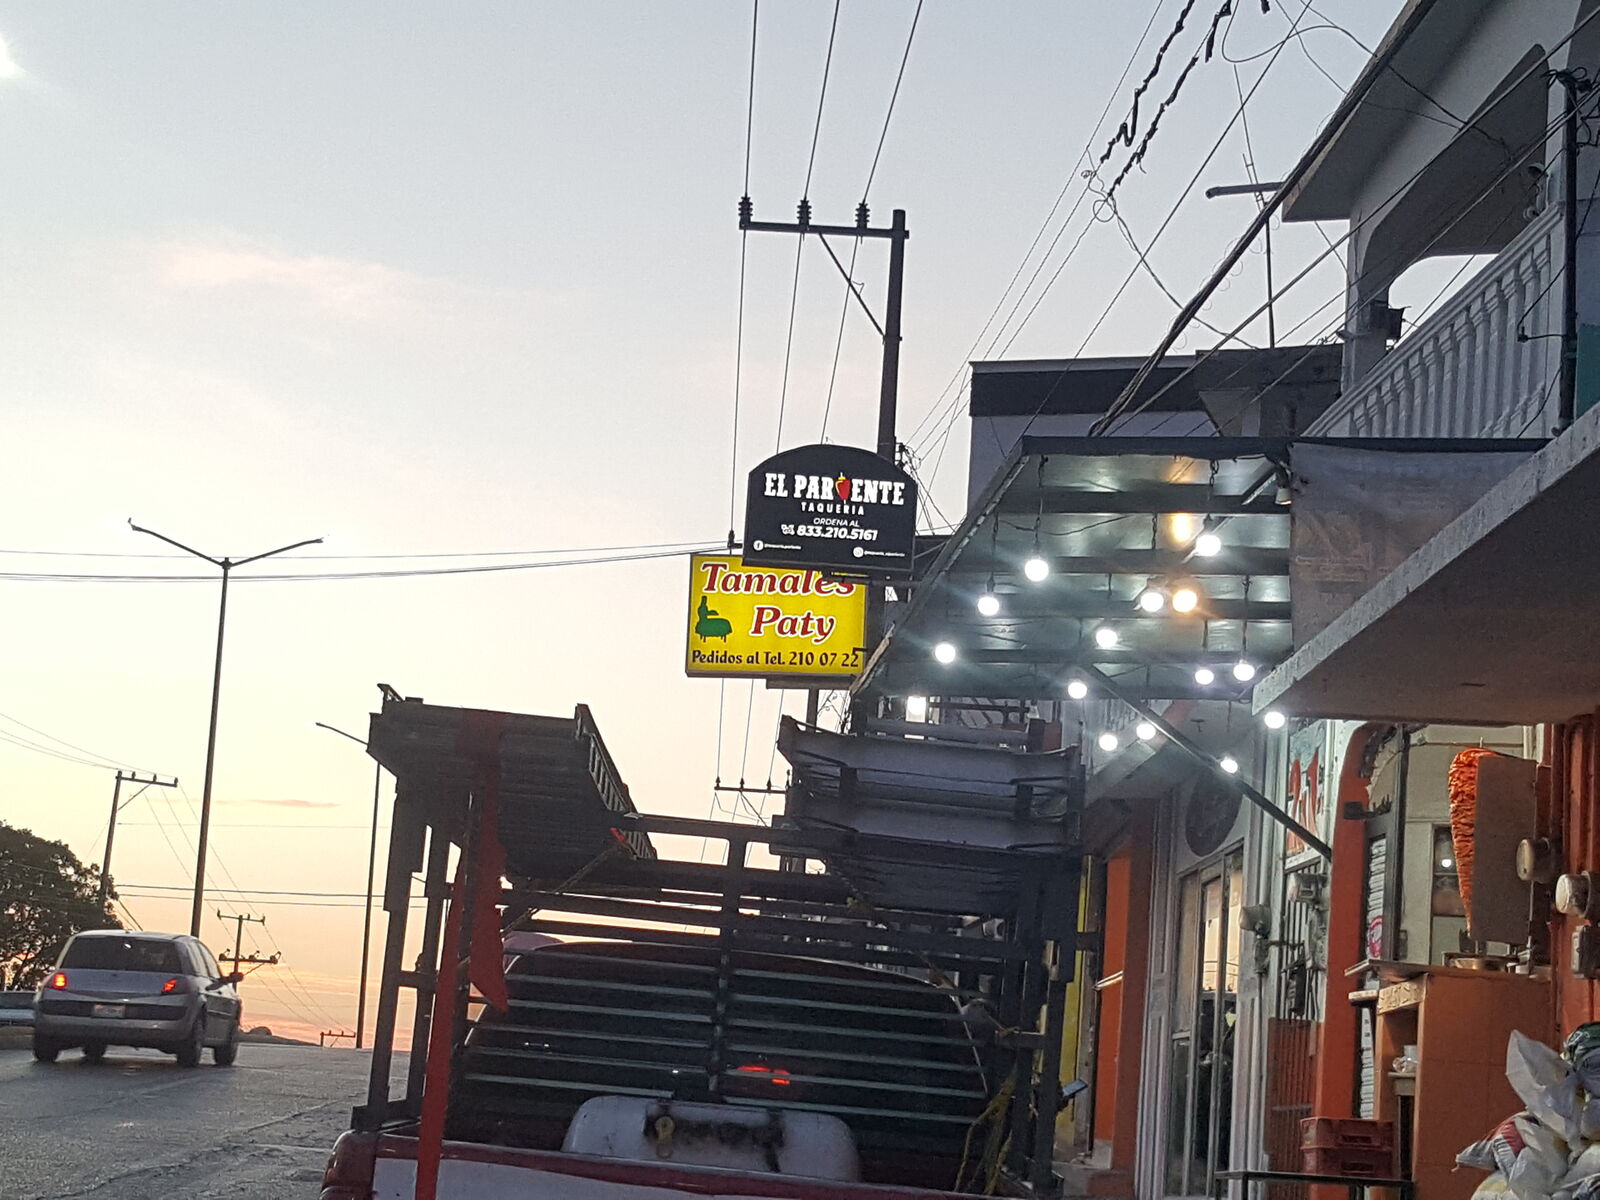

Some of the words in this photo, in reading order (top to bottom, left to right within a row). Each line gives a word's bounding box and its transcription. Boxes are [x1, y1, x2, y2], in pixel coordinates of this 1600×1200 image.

[764, 472, 788, 497] EL
[793, 473, 905, 505] PARENTE
[801, 501, 864, 515] TAQUERIA
[813, 517, 848, 527] ORDENA
[849, 519, 860, 528] AL
[796, 525, 878, 541] 833.210.5161
[702, 563, 855, 596] Tamales
[751, 606, 835, 643] Paty
[692, 649, 743, 664] Pedidos
[746, 651, 760, 664] al
[763, 651, 785, 665] Tel.
[788, 651, 815, 666] 210
[819, 652, 838, 667] 07
[840, 652, 859, 668] 22
